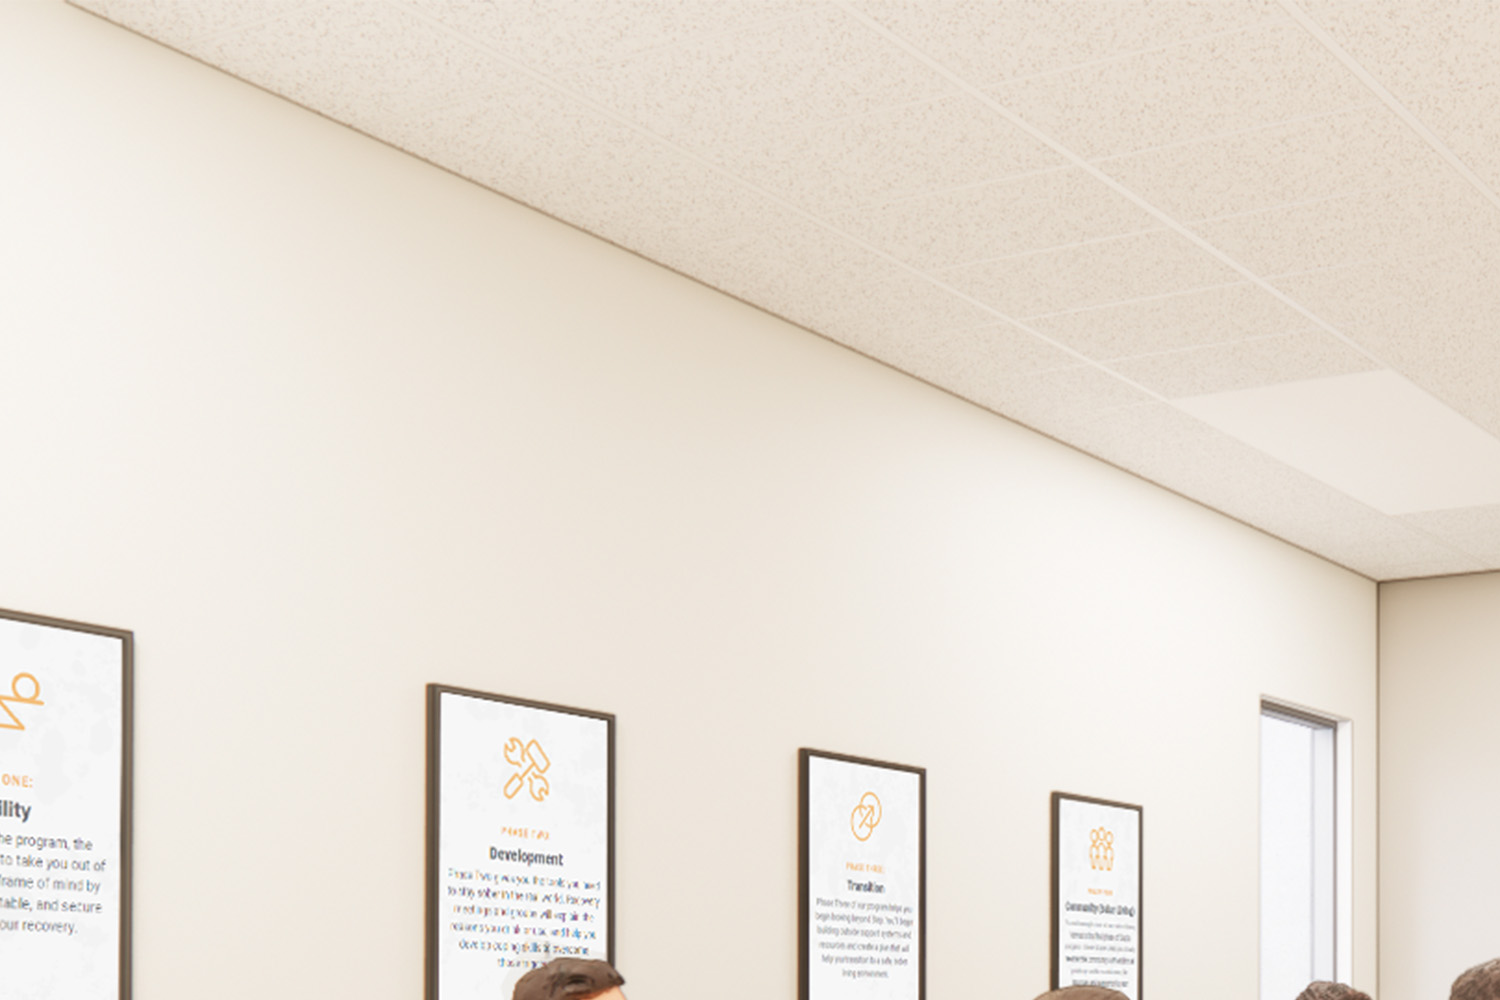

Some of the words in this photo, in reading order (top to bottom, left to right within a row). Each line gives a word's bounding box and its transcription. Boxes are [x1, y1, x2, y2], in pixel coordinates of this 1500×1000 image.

[1, 773, 33, 788] ONE:
[15, 834, 70, 851] program,
[73, 837, 93, 851] the
[16, 855, 43, 868] take
[46, 858, 68, 871] you
[71, 860, 91, 872] out
[93, 859, 106, 872] of
[489, 846, 564, 866] Development
[0, 874, 34, 889] rame
[37, 877, 50, 889] of
[53, 878, 84, 891] mind
[86, 879, 101, 895] by
[847, 879, 886, 893] Transition
[36, 899, 58, 912] and
[61, 901, 103, 914] secure
[22, 920, 78, 935] recovery.
